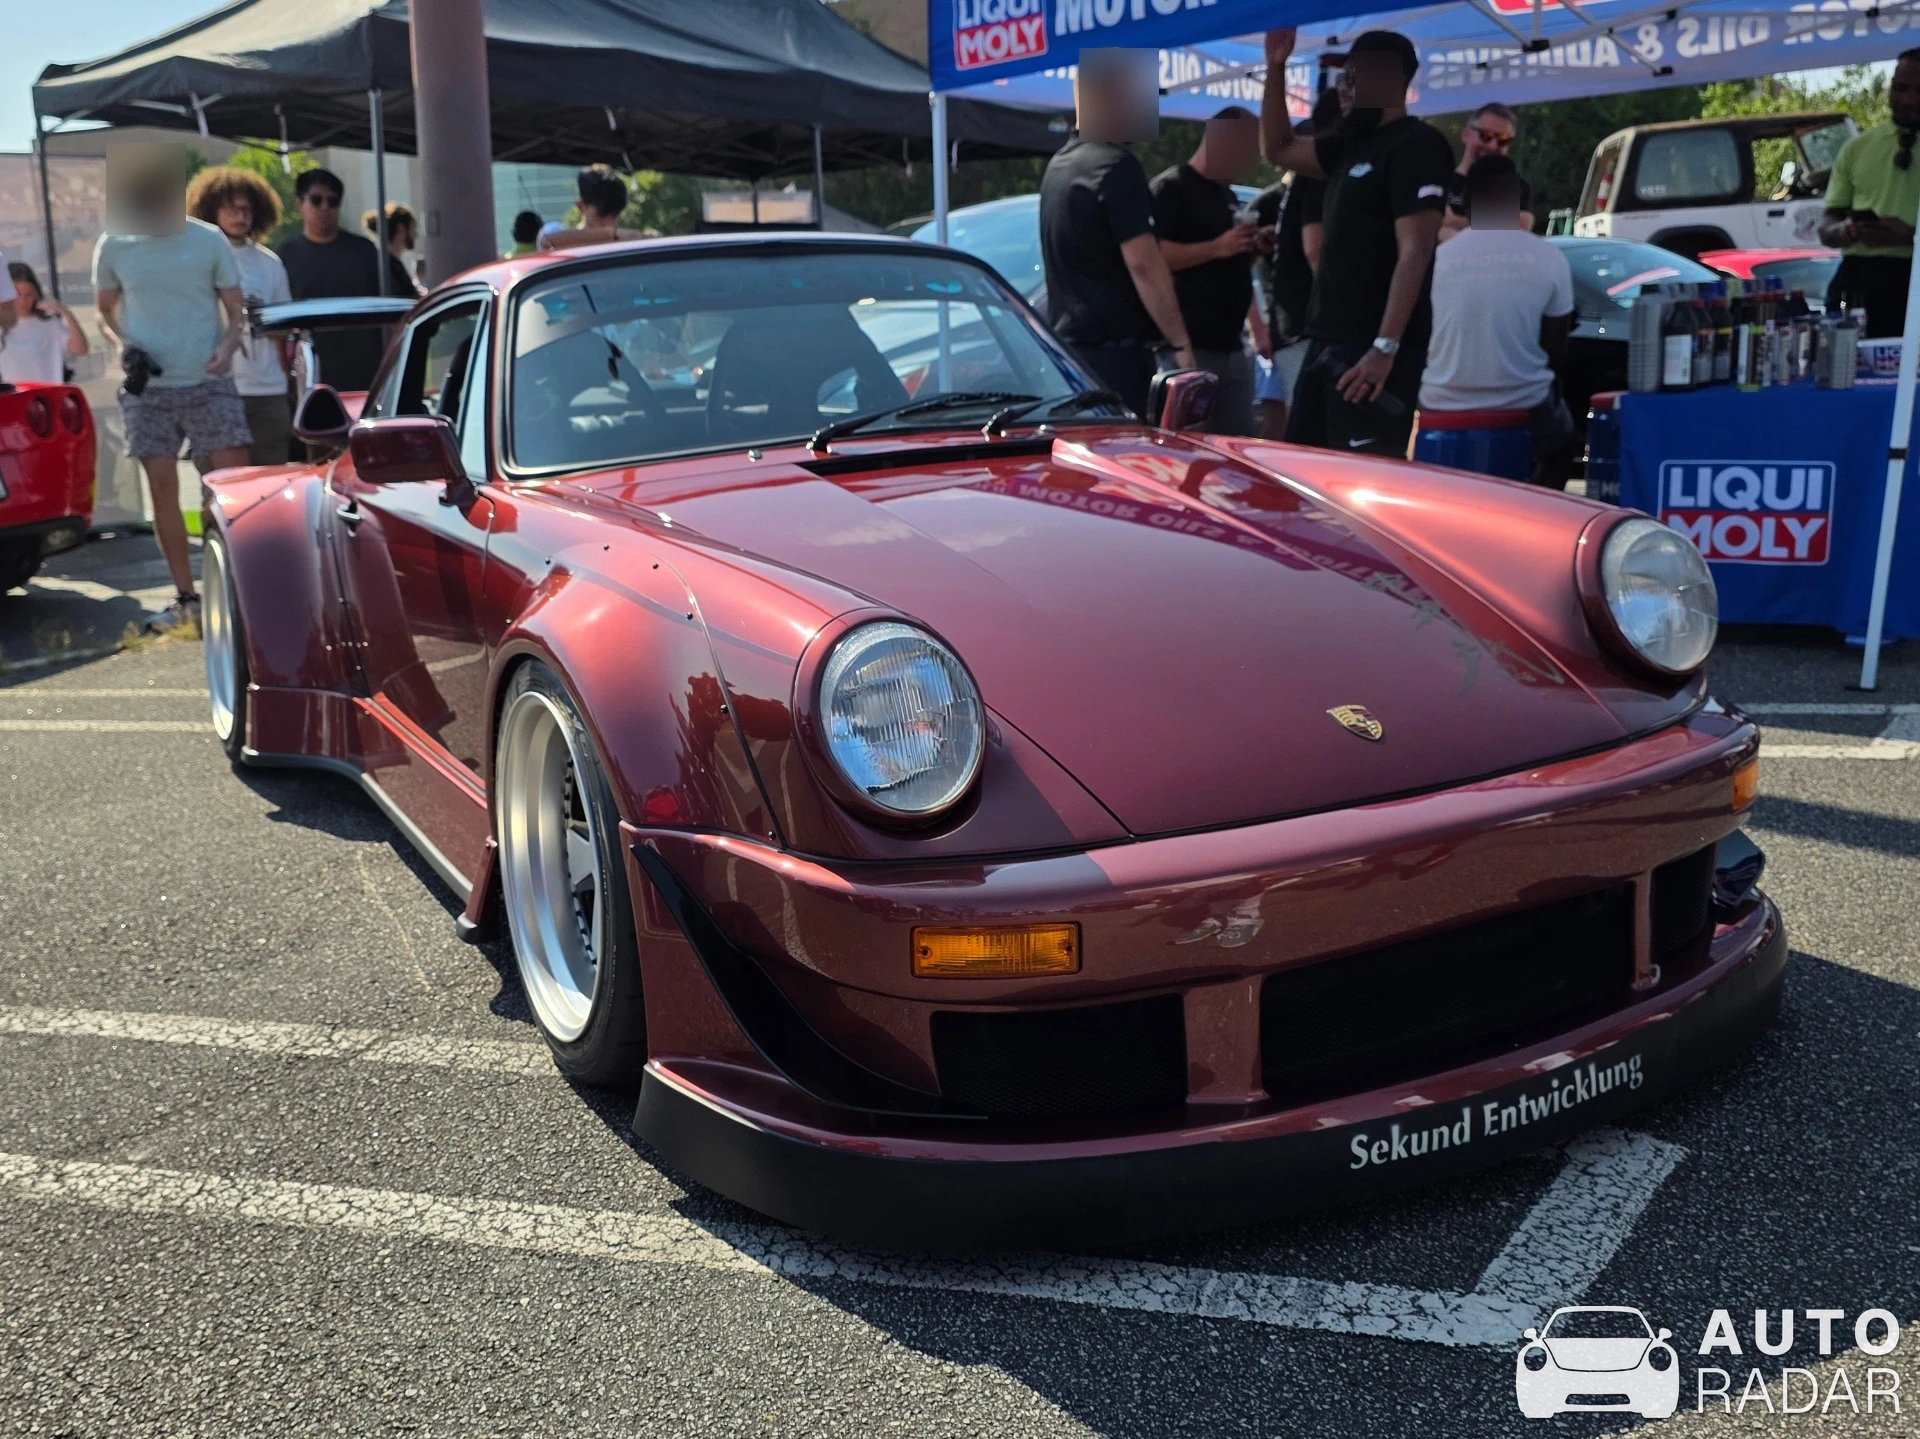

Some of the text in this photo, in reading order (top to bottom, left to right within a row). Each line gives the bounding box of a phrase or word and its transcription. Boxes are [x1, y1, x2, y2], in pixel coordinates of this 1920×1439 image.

[960, 15, 1044, 64] MOLY
[1668, 466, 1824, 511] LIQUI
[1667, 514, 1826, 559] MOLY
[1350, 1053, 1643, 1170] Sekund Entwicklung
